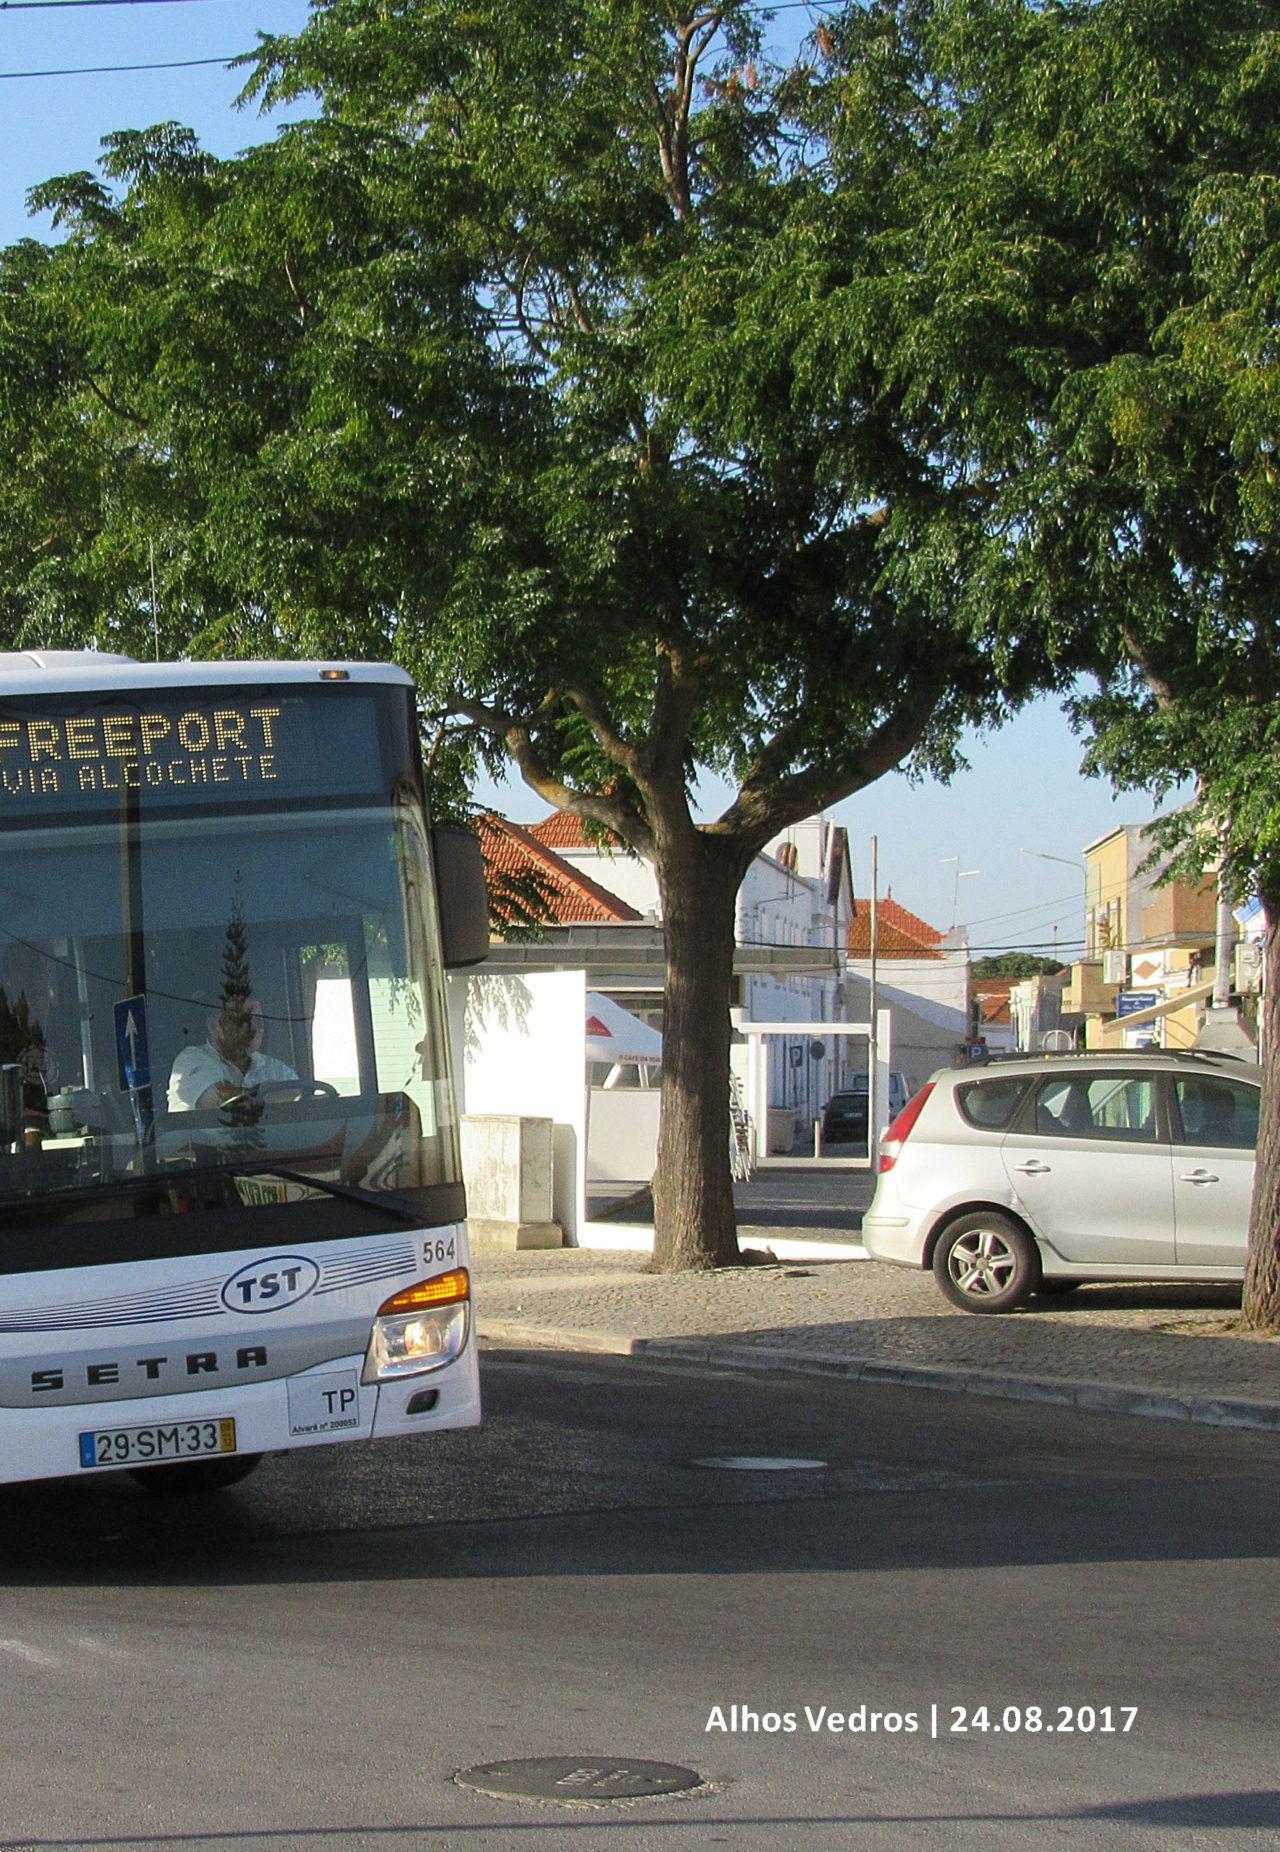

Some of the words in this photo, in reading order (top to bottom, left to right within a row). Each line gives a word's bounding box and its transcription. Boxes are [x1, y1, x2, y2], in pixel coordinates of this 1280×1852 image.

[2, 766, 58, 793] VIA
[79, 754, 277, 791] ALCOCHETE
[423, 1237, 455, 1263] 564
[236, 1265, 302, 1304] TST
[31, 1346, 268, 1392] SETRA
[322, 1388, 355, 1414] TP
